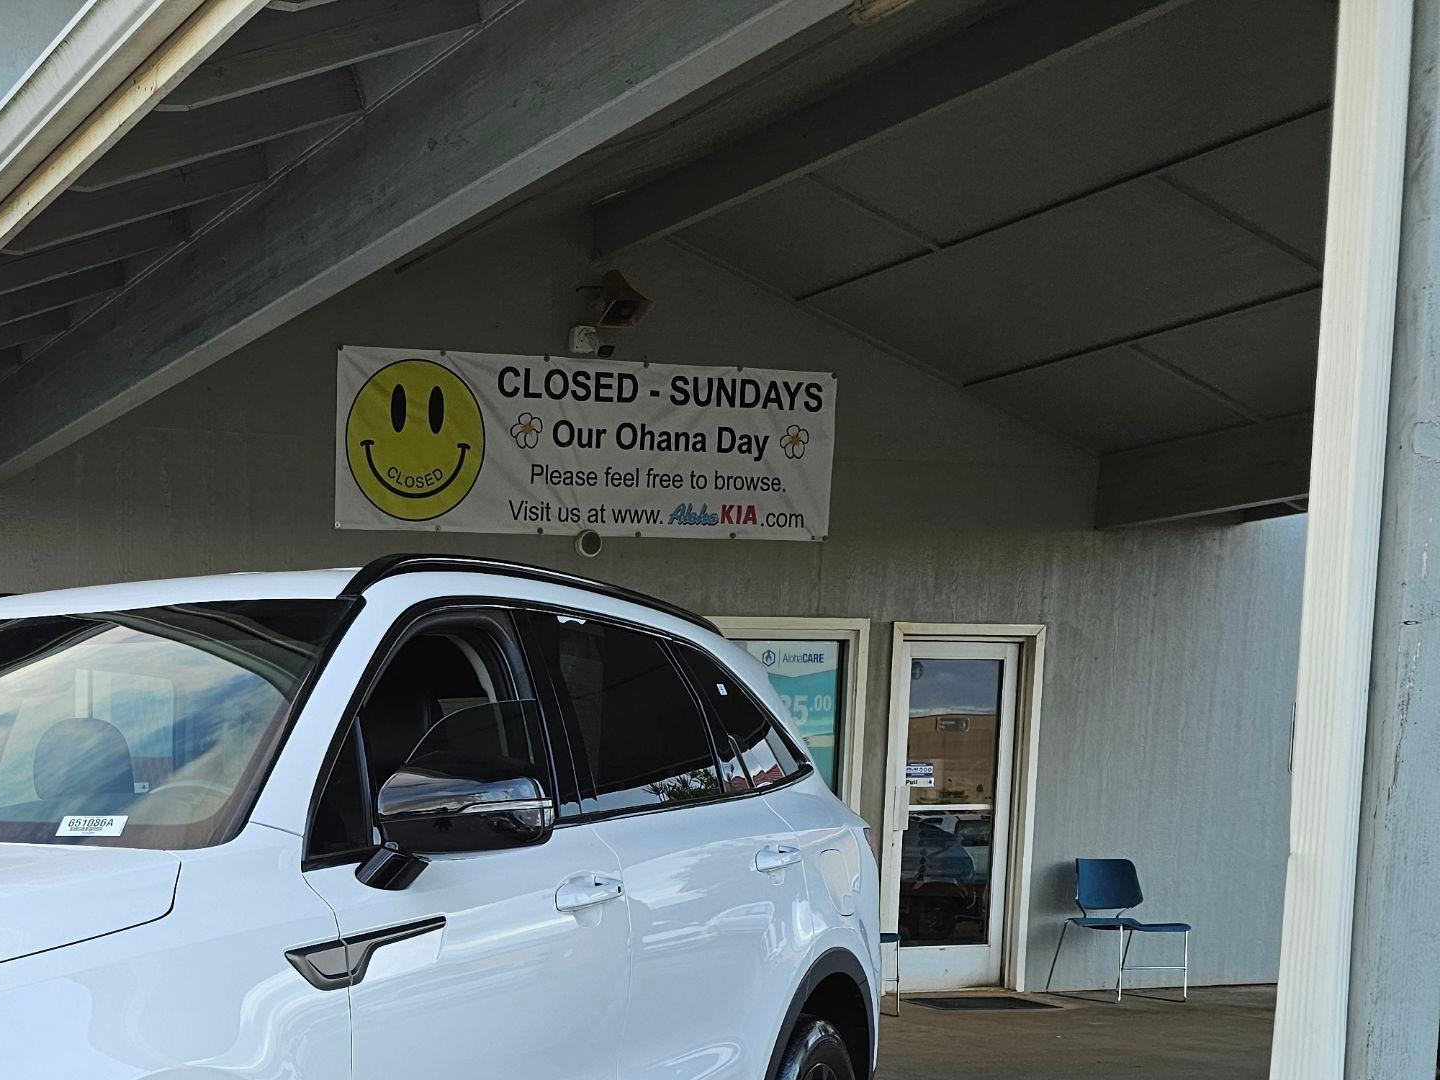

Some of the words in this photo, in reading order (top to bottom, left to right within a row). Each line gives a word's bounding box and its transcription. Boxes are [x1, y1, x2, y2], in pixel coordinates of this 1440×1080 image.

[497, 366, 639, 403] CLOSED
[669, 375, 823, 413] SUNDAYS
[552, 420, 607, 449] Our
[615, 422, 707, 453] Ohana
[716, 426, 769, 462] Day
[387, 466, 443, 489] CLOSED
[530, 463, 598, 486] Please
[604, 467, 640, 488] feel
[646, 468, 684, 489] free
[690, 470, 708, 490] to
[714, 470, 786, 493] browse.
[509, 500, 552, 522] Visit
[557, 506, 581, 523] us
[586, 504, 607, 524] at
[783, 653, 824, 663] AlohaCARE
